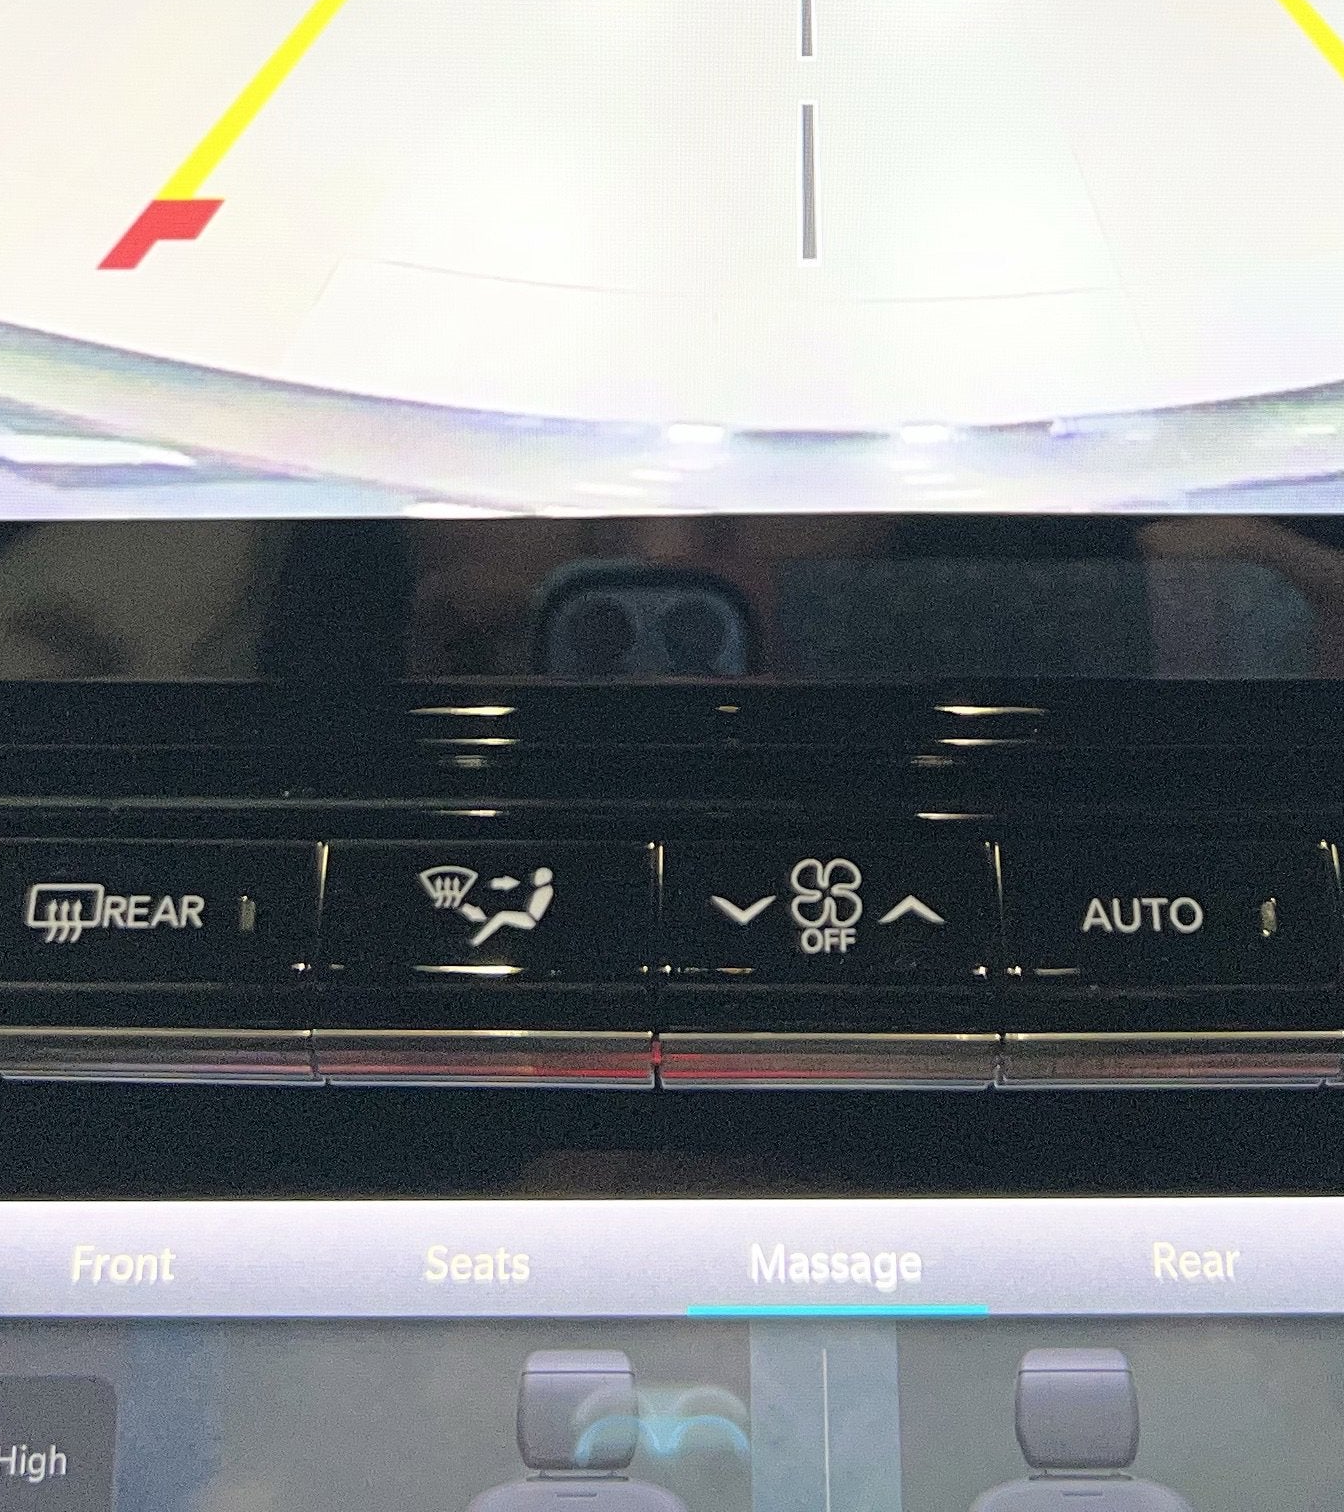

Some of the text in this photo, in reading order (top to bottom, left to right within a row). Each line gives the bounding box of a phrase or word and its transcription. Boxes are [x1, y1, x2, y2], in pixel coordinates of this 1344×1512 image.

[102, 895, 205, 928] REAR
[1081, 896, 1204, 933] AUTO
[800, 927, 856, 954] OFF
[70, 1245, 176, 1284] Front
[424, 1245, 531, 1284] Seats
[750, 1243, 924, 1292] Massage
[1151, 1244, 1241, 1282] Rear
